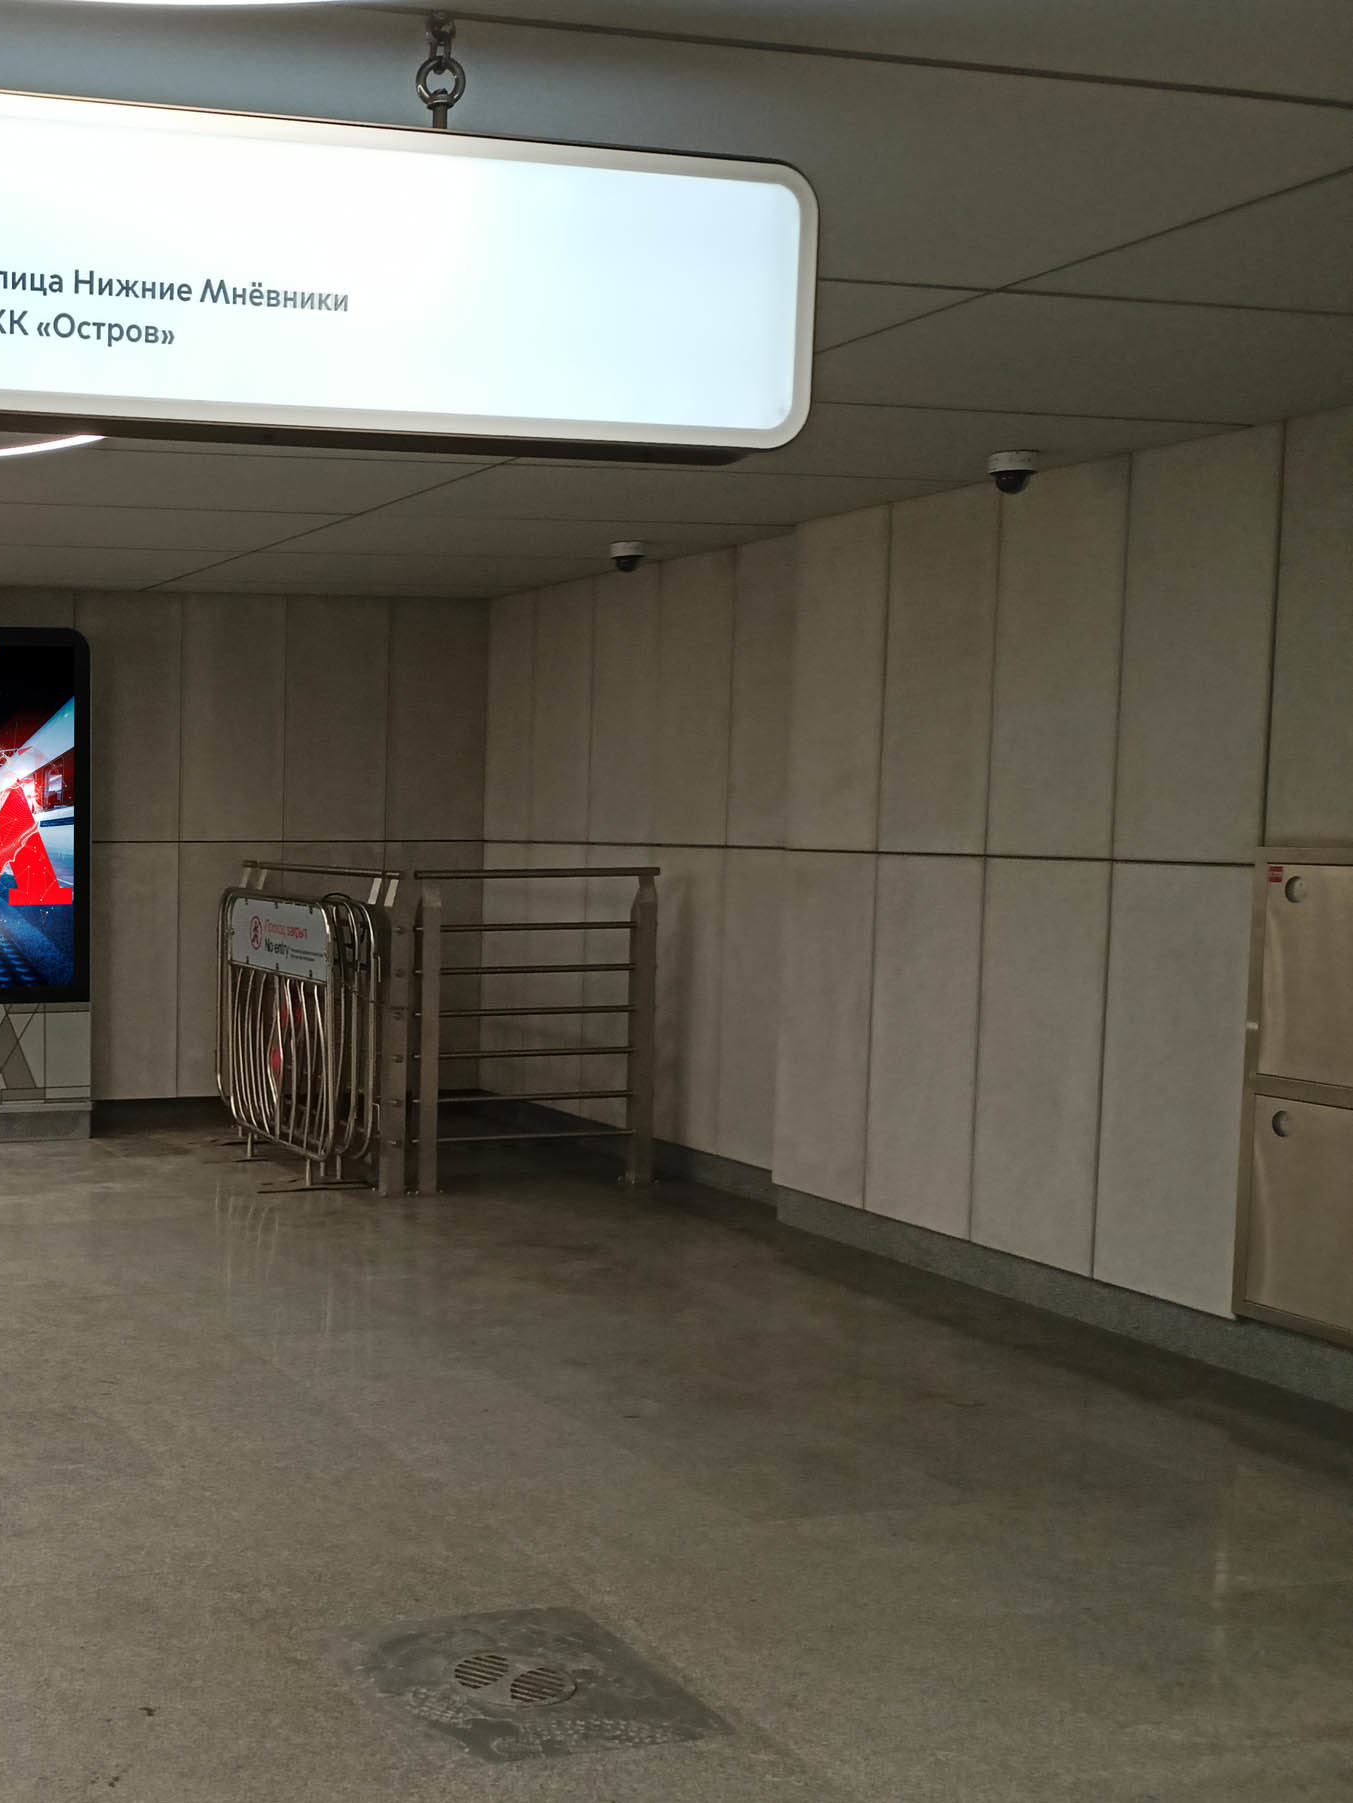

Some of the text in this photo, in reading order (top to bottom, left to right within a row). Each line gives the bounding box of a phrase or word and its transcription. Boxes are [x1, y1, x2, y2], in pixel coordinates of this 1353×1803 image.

[73, 268, 193, 302] Нижние
[199, 278, 349, 313] Мнёвники
[36, 312, 176, 348] «Остров»
